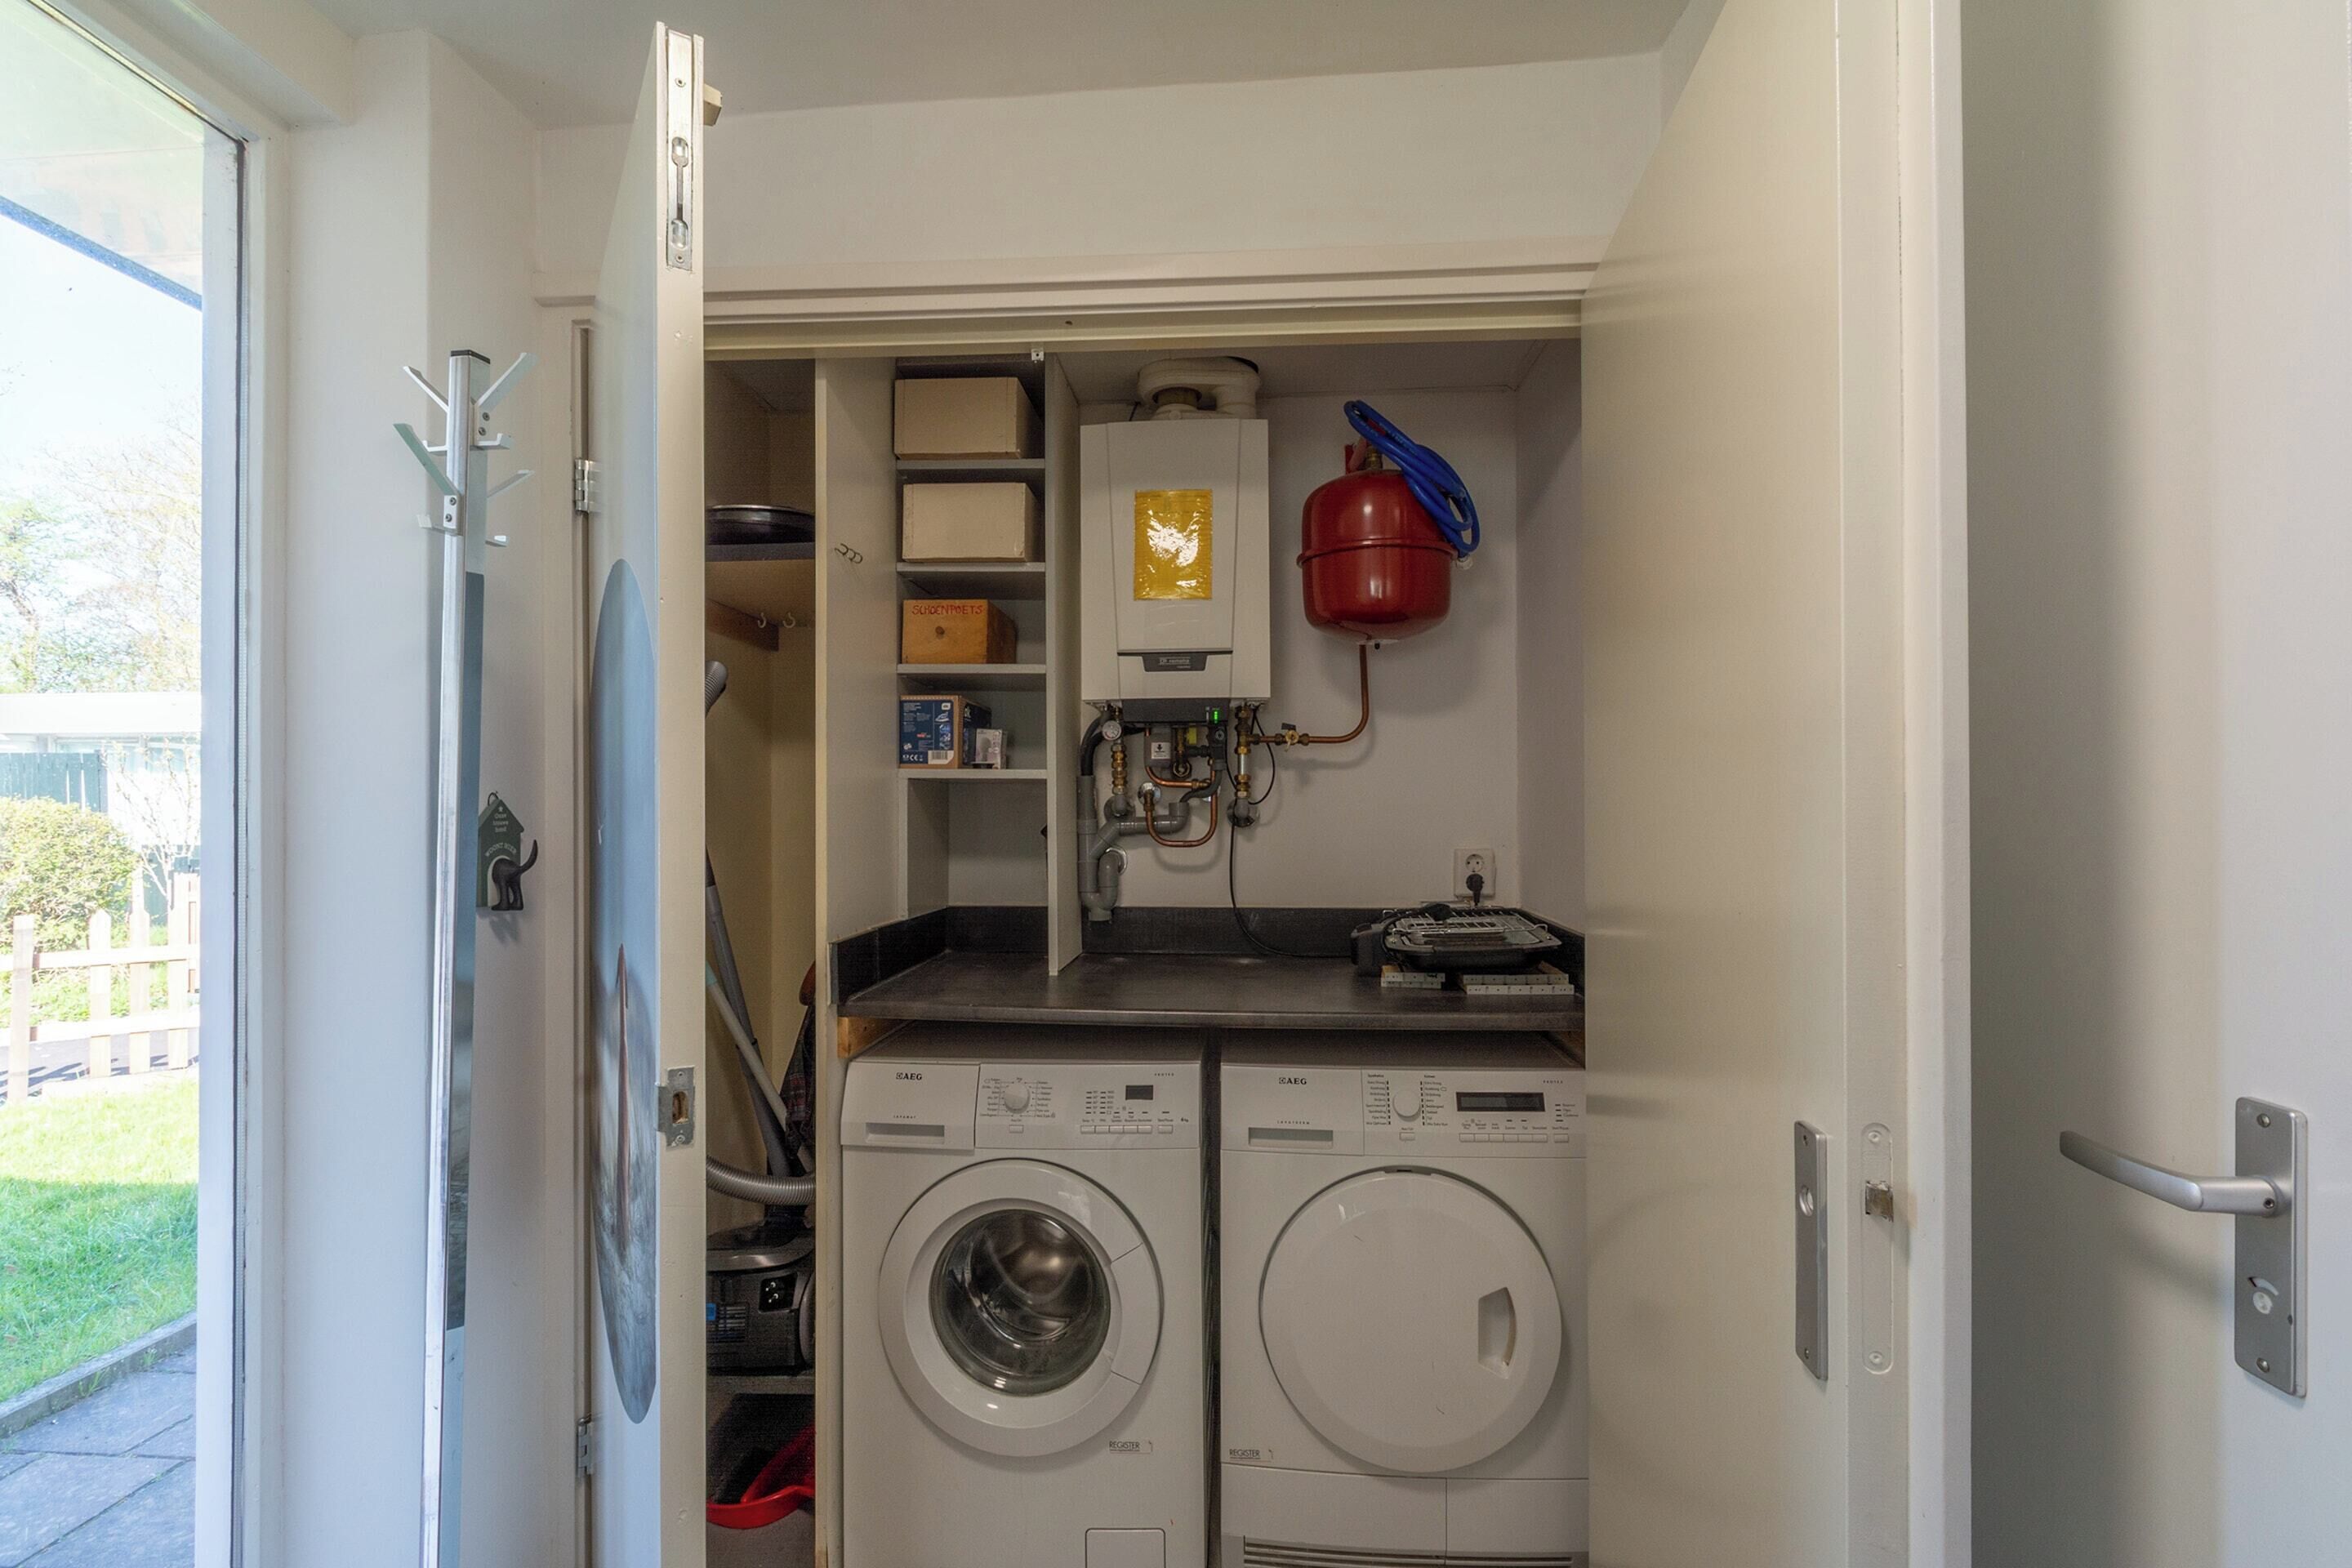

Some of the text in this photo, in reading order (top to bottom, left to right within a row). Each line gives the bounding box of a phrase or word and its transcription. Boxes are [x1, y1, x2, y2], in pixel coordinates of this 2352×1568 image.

[911, 604, 983, 615] SCHOENPOETS
[903, 1072, 923, 1080] AEG
[1286, 1077, 1307, 1085] AEG
[1109, 1441, 1140, 1450] REGISTER
[1229, 1449, 1260, 1458] REGISTER
